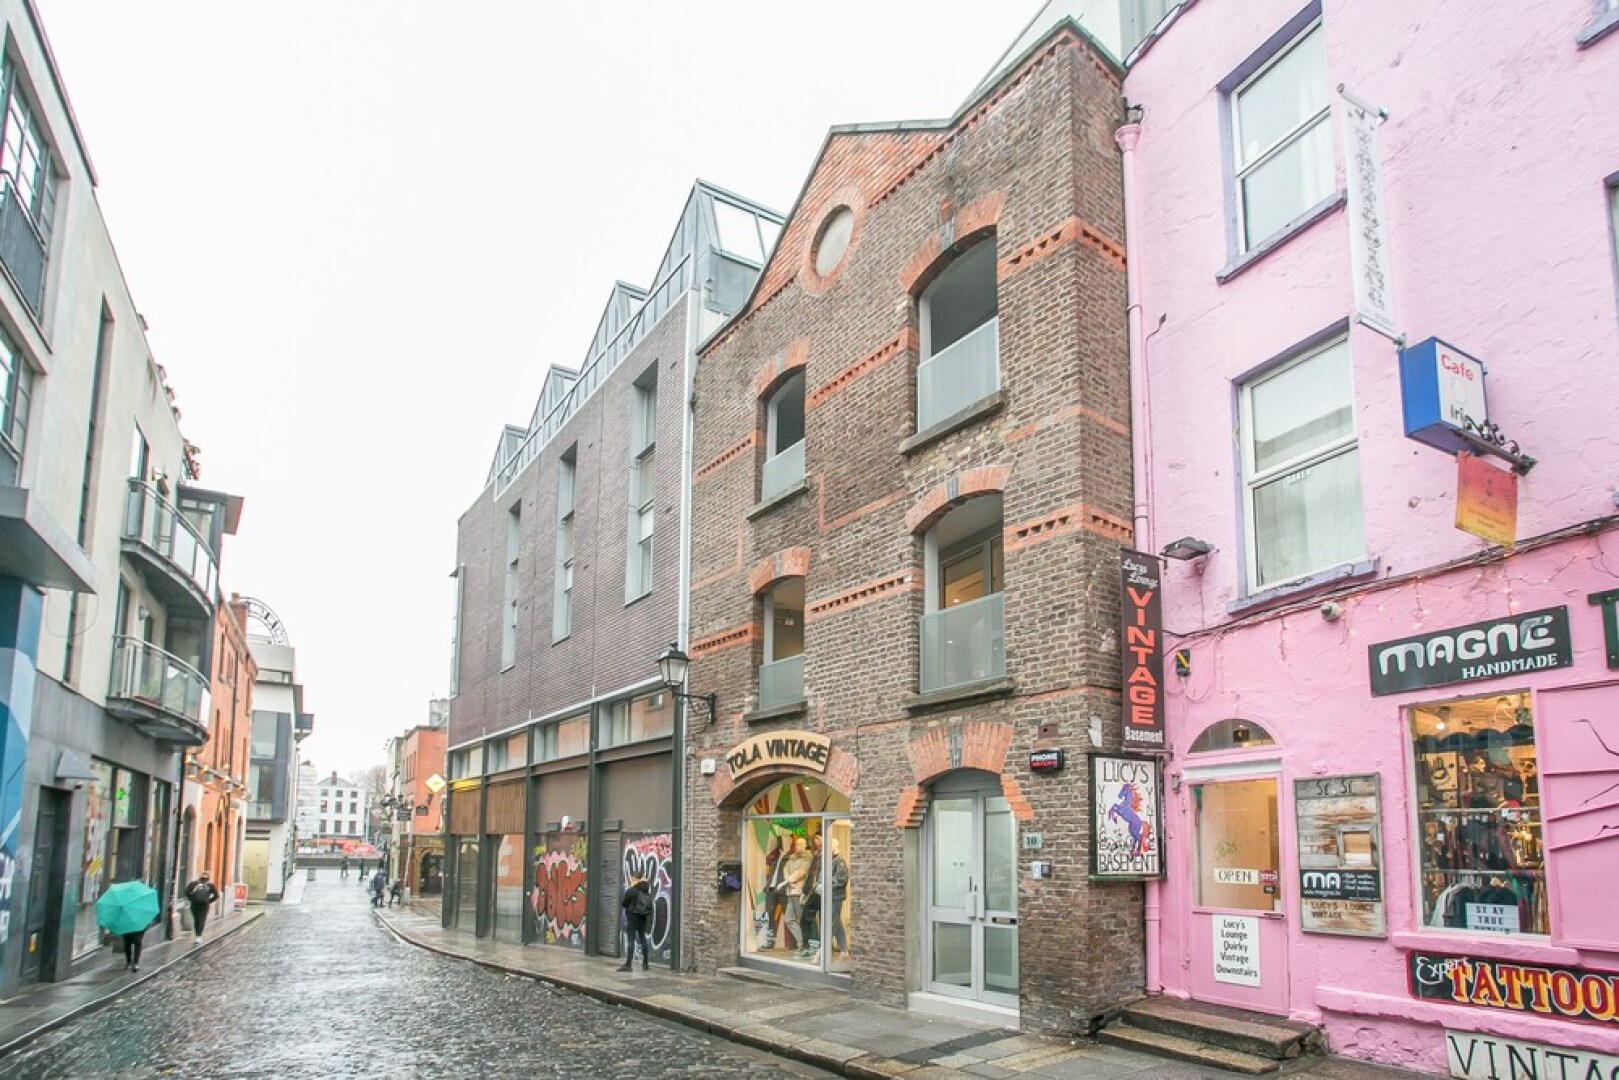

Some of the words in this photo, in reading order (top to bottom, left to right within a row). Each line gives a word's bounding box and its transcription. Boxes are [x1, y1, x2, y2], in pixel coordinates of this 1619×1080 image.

[1440, 353, 1475, 382] Cafe
[1378, 614, 1555, 676] MAGNE
[1126, 586, 1157, 726] VINTAGE
[1462, 653, 1558, 680] HANDMADE
[1124, 726, 1163, 744] Basement
[726, 742, 762, 774] TOLA
[765, 738, 828, 766] VINTAGE
[1099, 853, 1156, 872] BASEMENT
[1218, 870, 1252, 882] OPEN
[1302, 872, 1341, 889] MA
[1478, 916, 1503, 926] TRUE
[1221, 929, 1248, 941] Lounge
[1223, 940, 1248, 953] Quirky
[1219, 952, 1249, 965] Vintage
[1216, 964, 1258, 978] Downstairs
